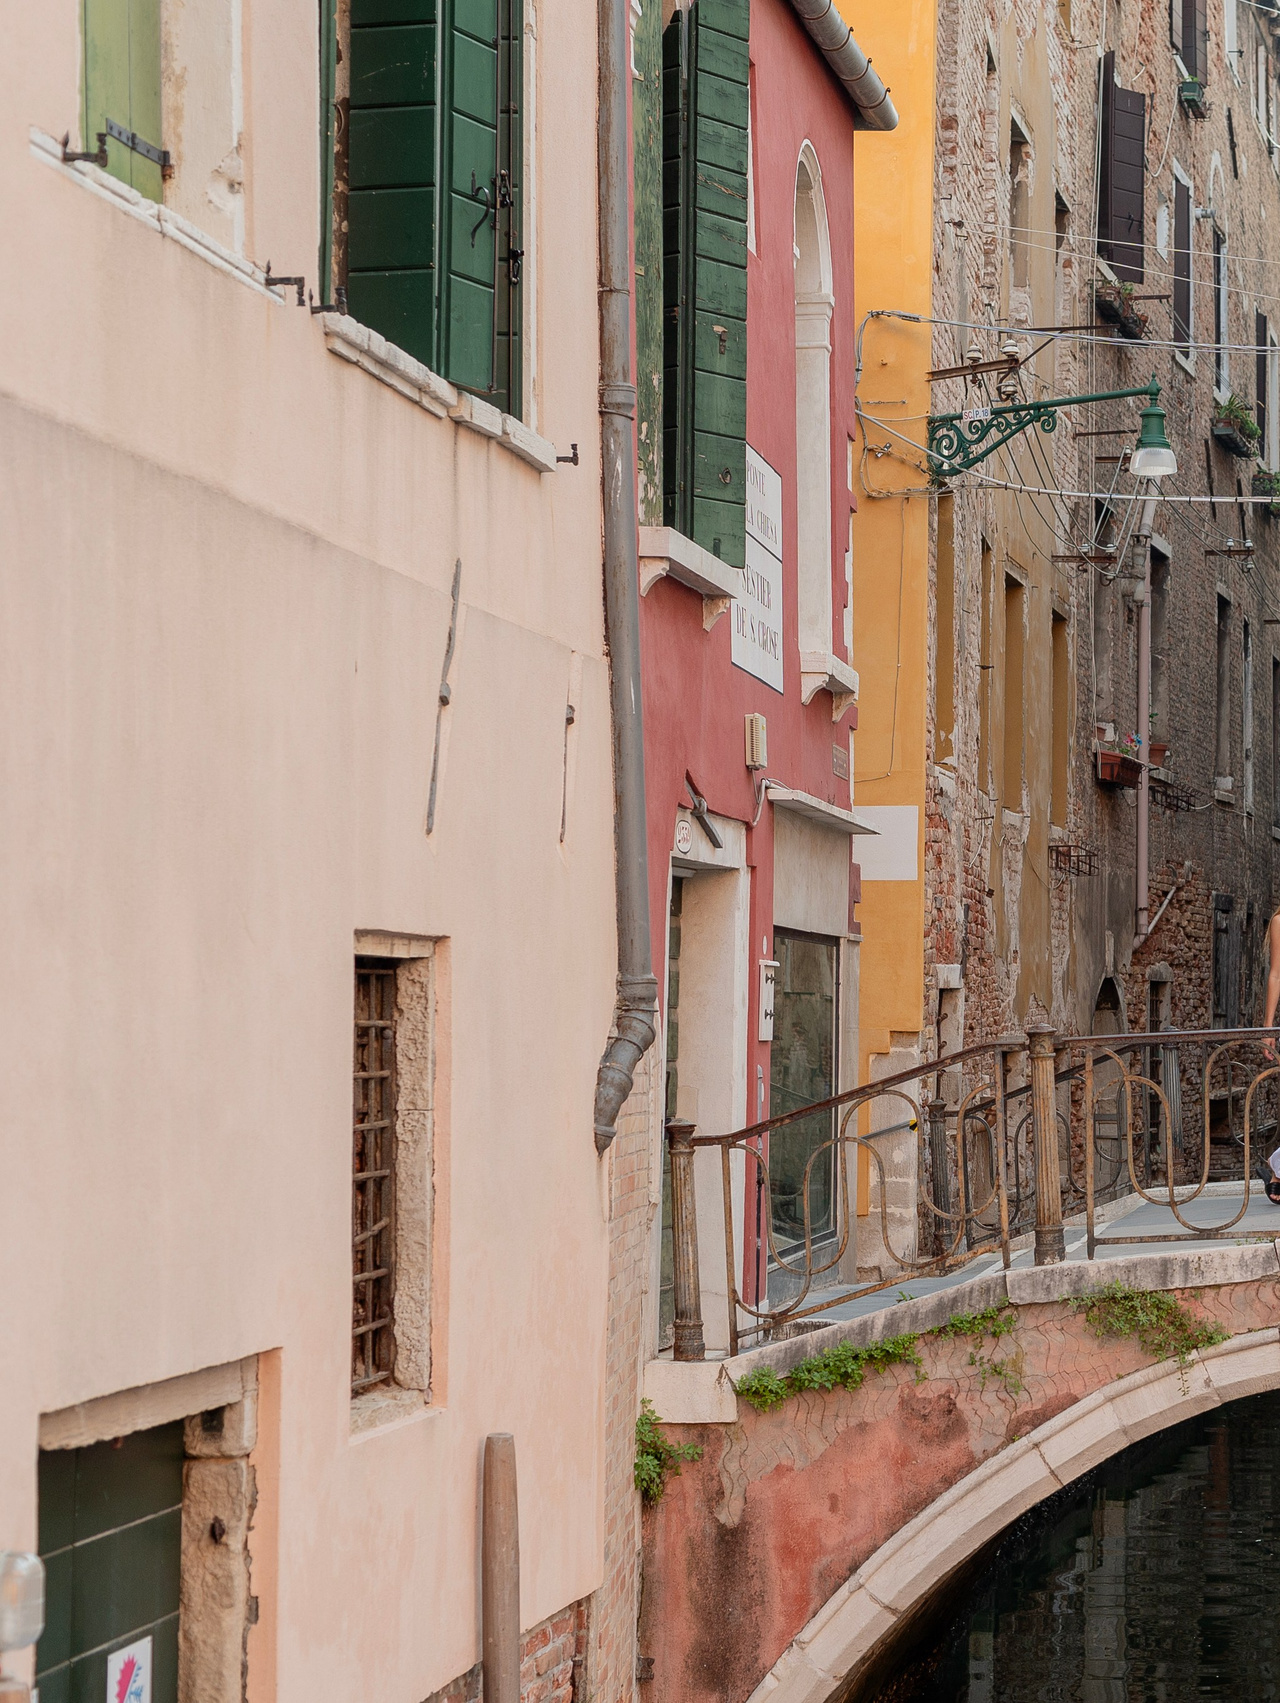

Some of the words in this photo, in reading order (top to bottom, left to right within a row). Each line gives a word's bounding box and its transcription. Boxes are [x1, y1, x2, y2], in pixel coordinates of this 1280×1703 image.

[746, 460, 766, 497] PONTE
[757, 510, 778, 545] CHIESA
[741, 564, 772, 611] SESTIER
[736, 604, 747, 639] DE
[757, 620, 779, 661] CROSE
